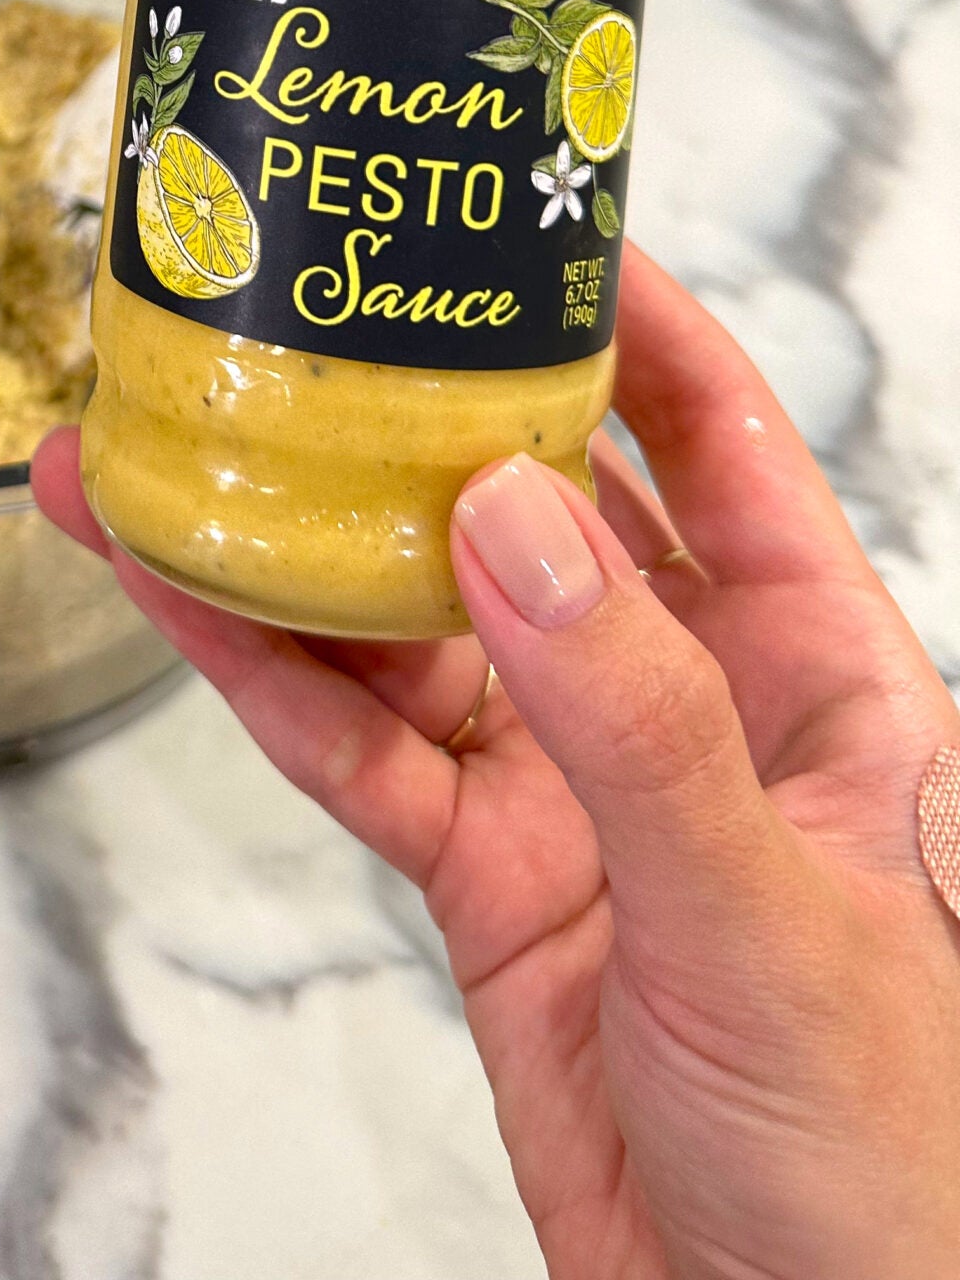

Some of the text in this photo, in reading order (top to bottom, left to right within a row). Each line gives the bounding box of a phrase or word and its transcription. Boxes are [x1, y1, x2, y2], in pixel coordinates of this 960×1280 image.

[214, 7, 523, 131] Lemon
[258, 136, 504, 231] PESTO
[293, 228, 522, 328] Sauce
[562, 257, 605, 283] NET WT.
[565, 279, 600, 305] 6.7 OZ
[562, 301, 598, 330] (190g)
